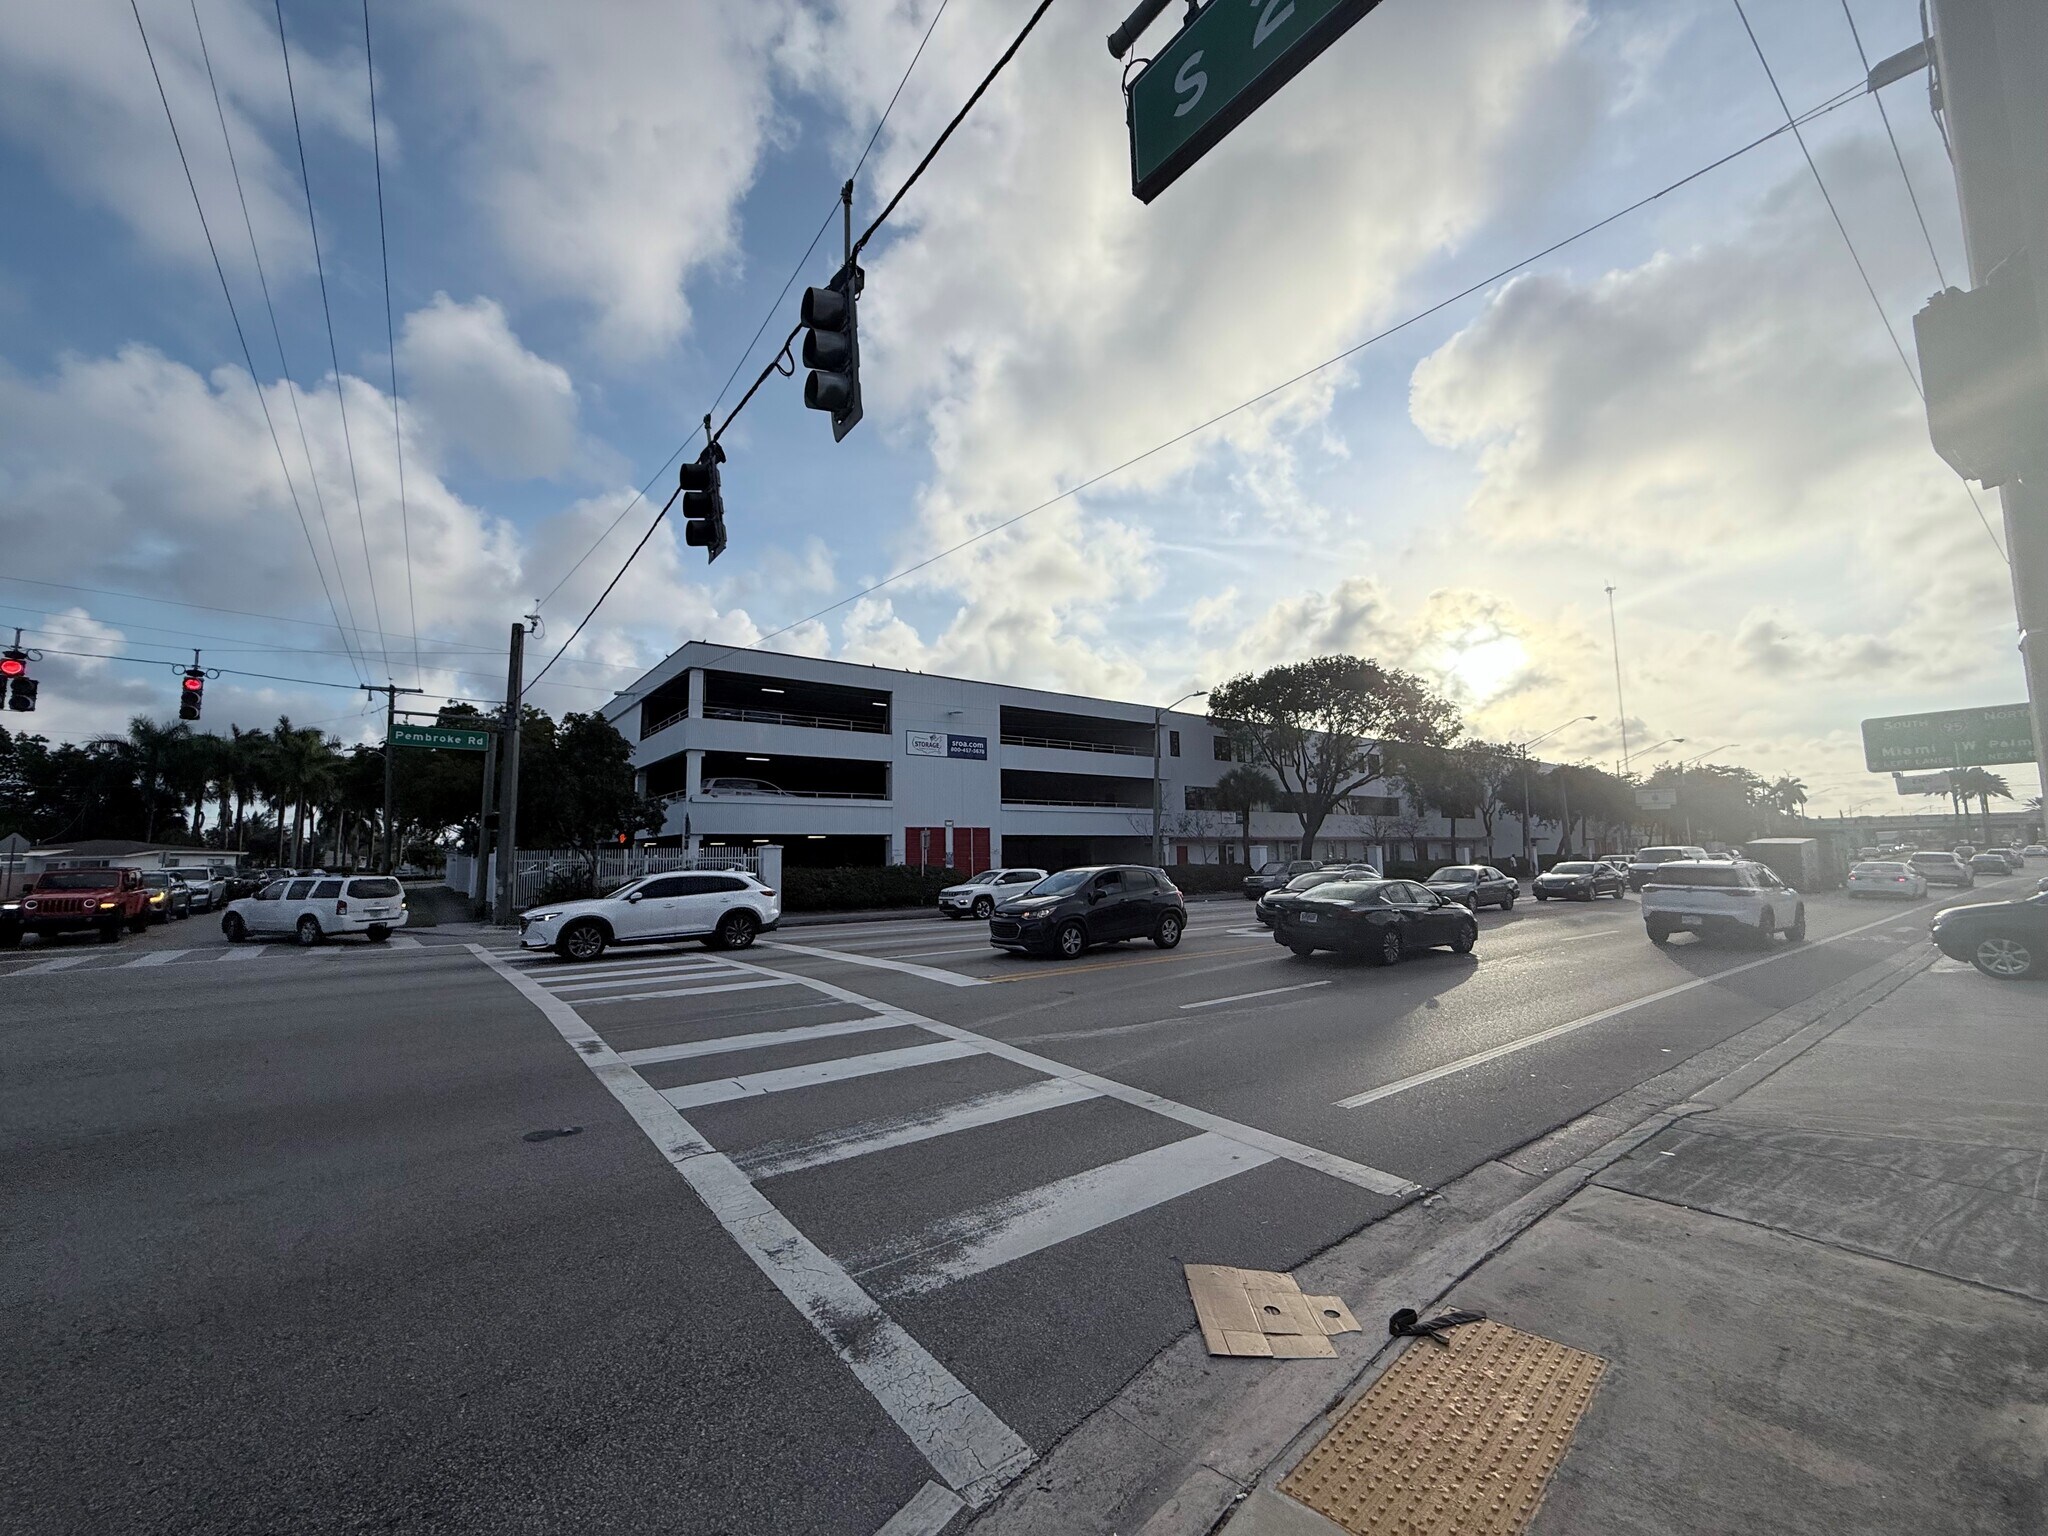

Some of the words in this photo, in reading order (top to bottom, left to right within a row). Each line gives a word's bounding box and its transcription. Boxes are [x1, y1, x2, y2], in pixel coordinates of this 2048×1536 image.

[1173, 49, 1208, 117] S
[1882, 719, 1929, 730] SOUTH
[1943, 721, 1964, 733] 95
[1984, 709, 2029, 721] NORT
[395, 731, 462, 743] Pembroke
[467, 736, 484, 745] Rd
[952, 740, 984, 748] sroa.com
[1961, 740, 1976, 751] W
[1989, 738, 2032, 749] Palm
[1882, 744, 1936, 757] Miami
[1915, 756, 1953, 766] LANES
